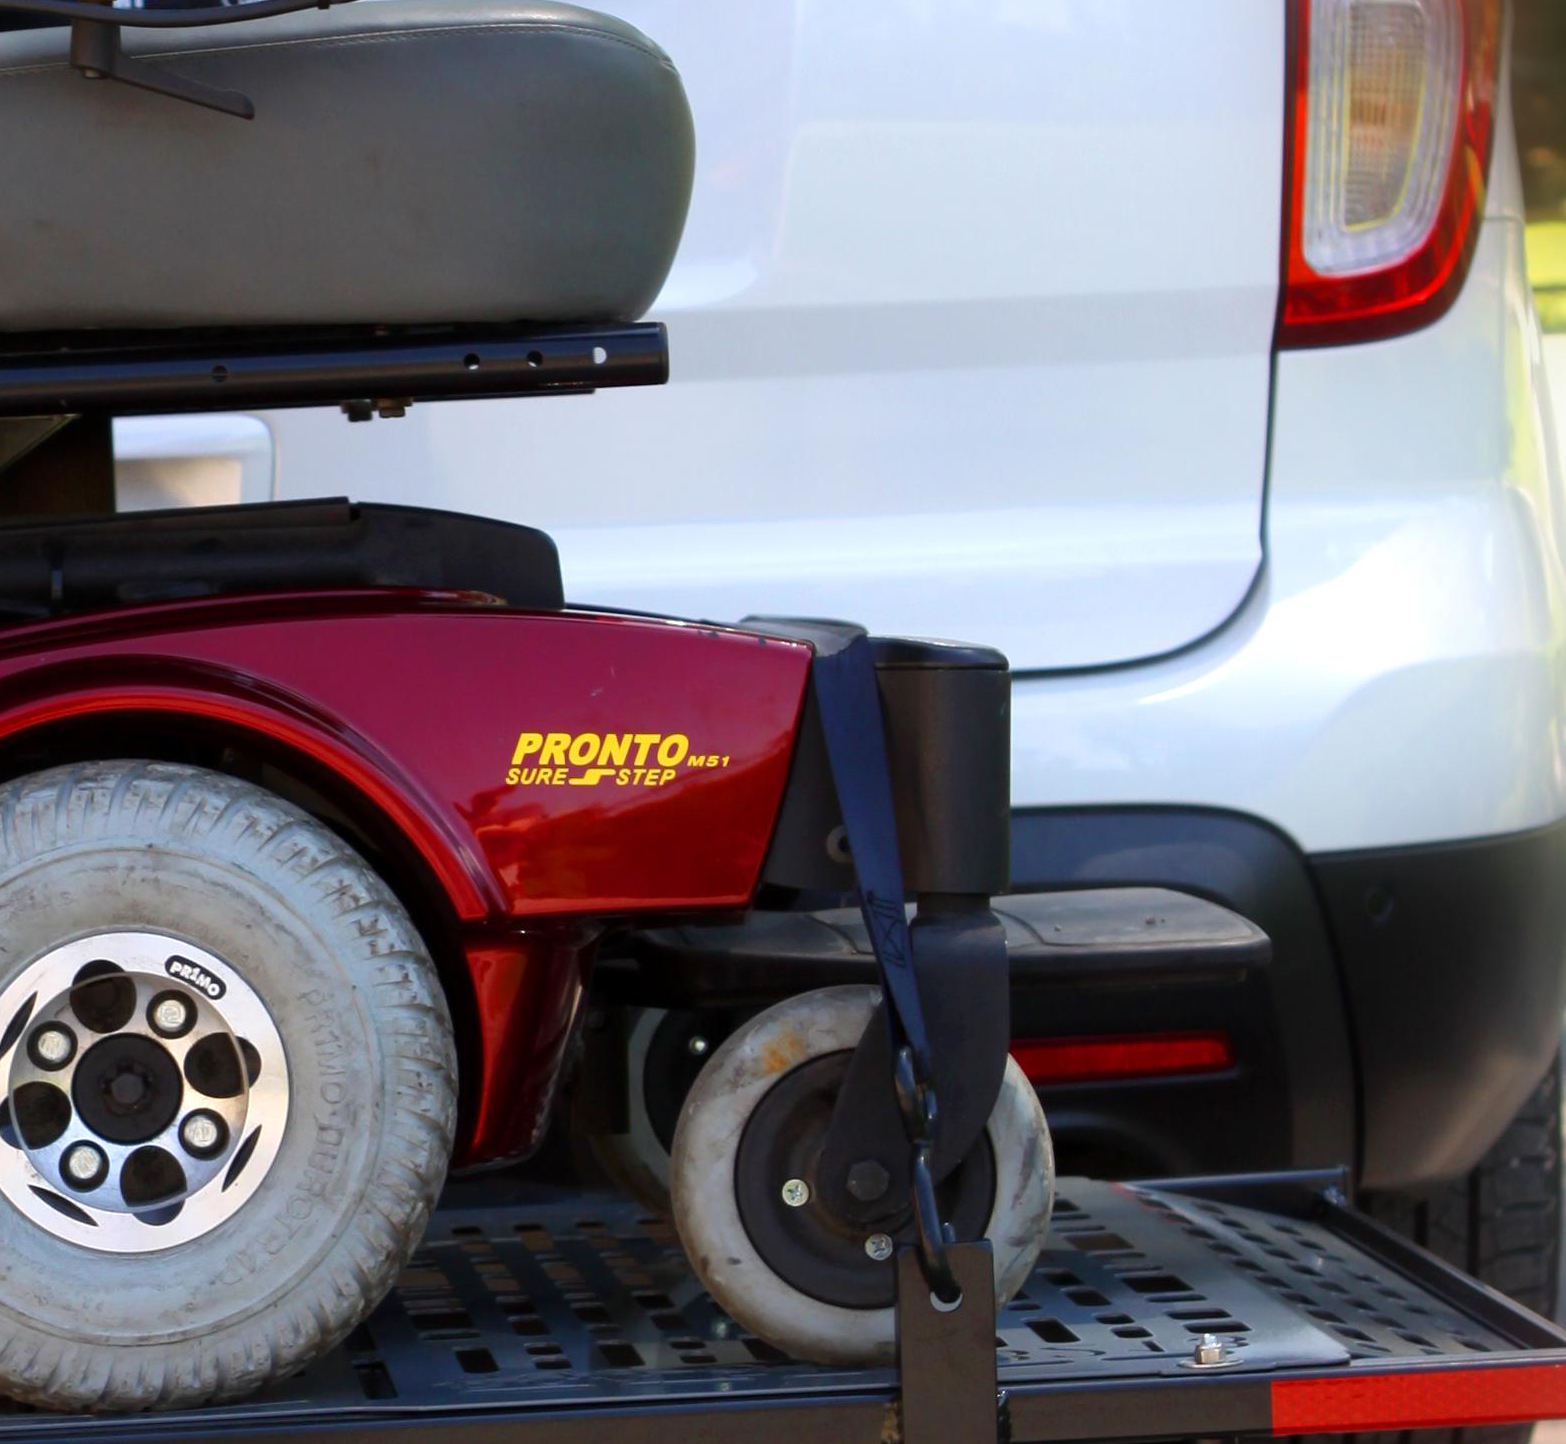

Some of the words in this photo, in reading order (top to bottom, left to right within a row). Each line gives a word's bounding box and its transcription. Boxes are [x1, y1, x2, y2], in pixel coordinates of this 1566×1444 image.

[511, 733, 689, 766] PRONTO
[688, 755, 730, 767] M51
[505, 768, 569, 785] SURE
[616, 769, 676, 786] STEP
